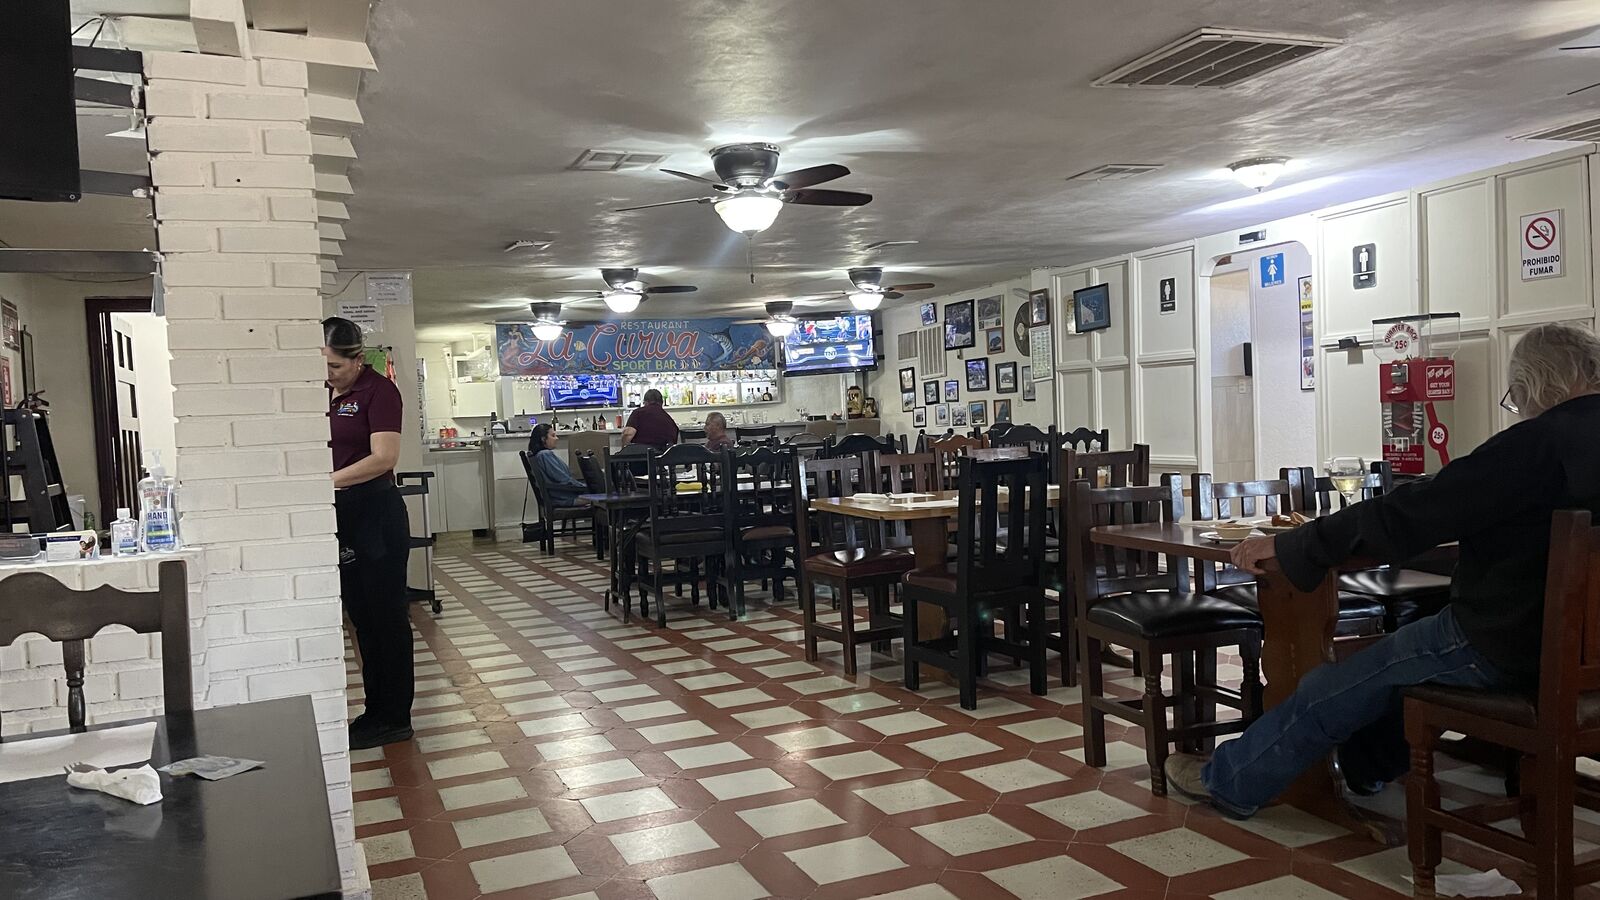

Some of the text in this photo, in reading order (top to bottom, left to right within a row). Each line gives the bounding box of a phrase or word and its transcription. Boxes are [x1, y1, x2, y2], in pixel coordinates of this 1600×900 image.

[1523, 254, 1560, 267] PROHIBIDO
[1530, 266, 1554, 276] FUMAR
[620, 320, 690, 331] RESTAURANT
[1384, 324, 1419, 344] QUARTER BACK
[518, 323, 705, 367] La Curva
[1394, 340, 1408, 350] 25¢
[612, 359, 677, 372] SPORT BAR
[1433, 430, 1444, 440] 25¢
[147, 511, 168, 521] HAND
